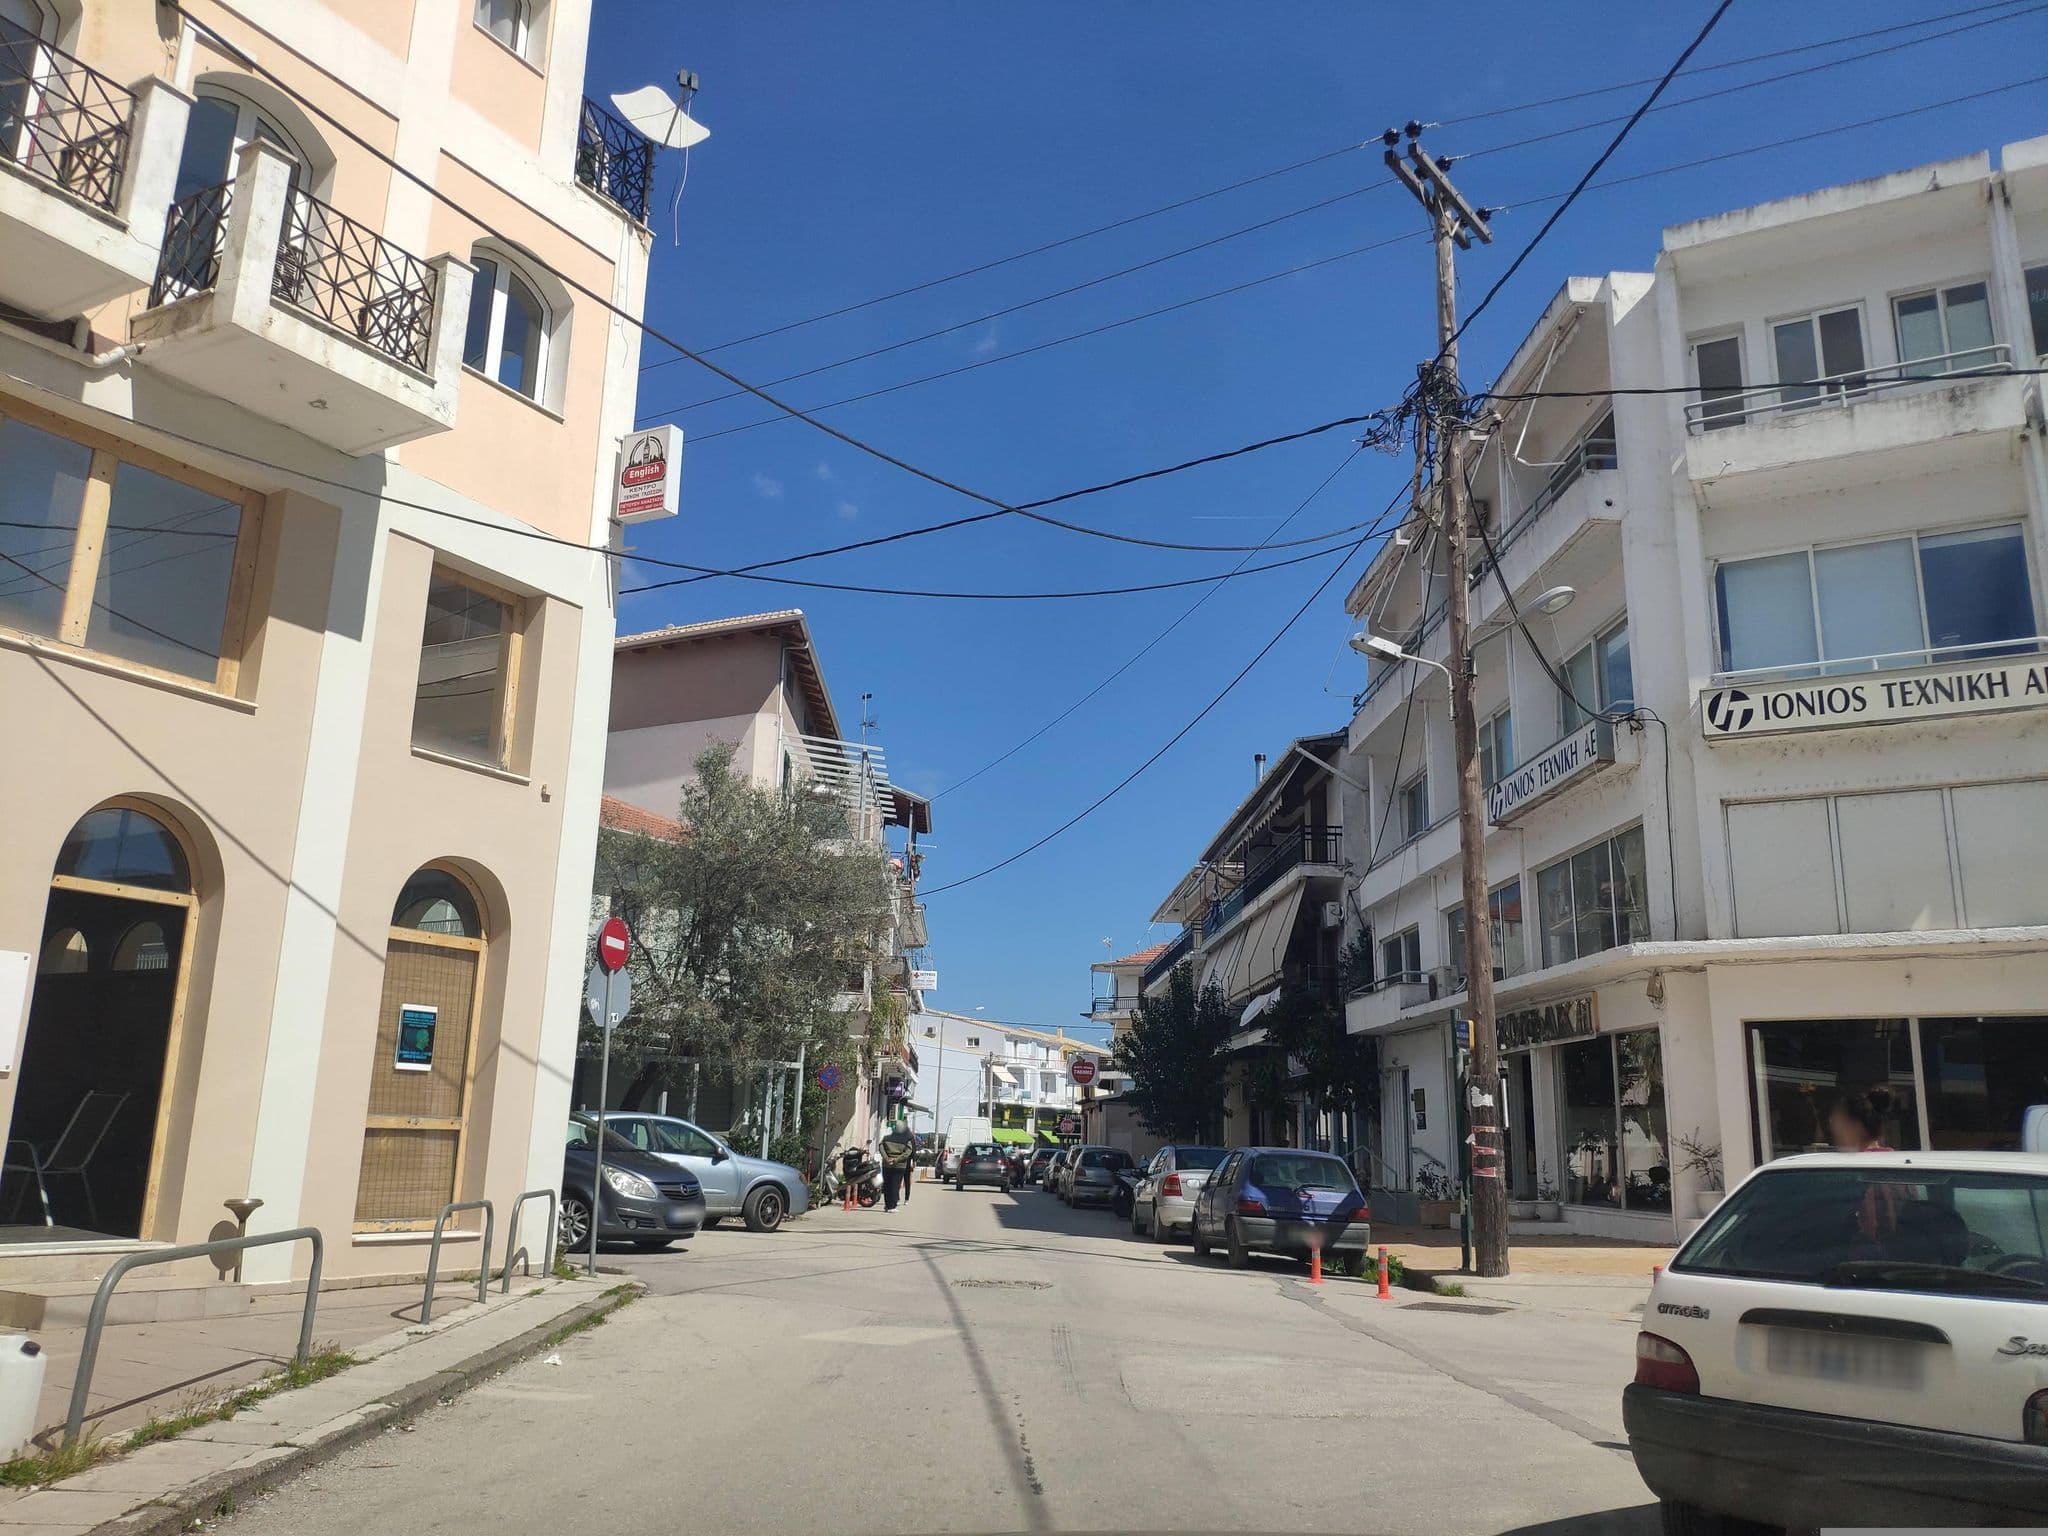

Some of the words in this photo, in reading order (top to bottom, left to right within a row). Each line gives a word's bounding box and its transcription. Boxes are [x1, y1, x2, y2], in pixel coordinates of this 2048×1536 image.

[629, 464, 659, 478] English
[629, 484, 656, 493] ΚΕΝΤΡΟ
[1880, 670, 2010, 709] ΤΕΧΝΙΚΗ
[1538, 740, 1578, 786] ΤΕΧΝΙΚΗ
[1584, 728, 1597, 761] ΑΕ
